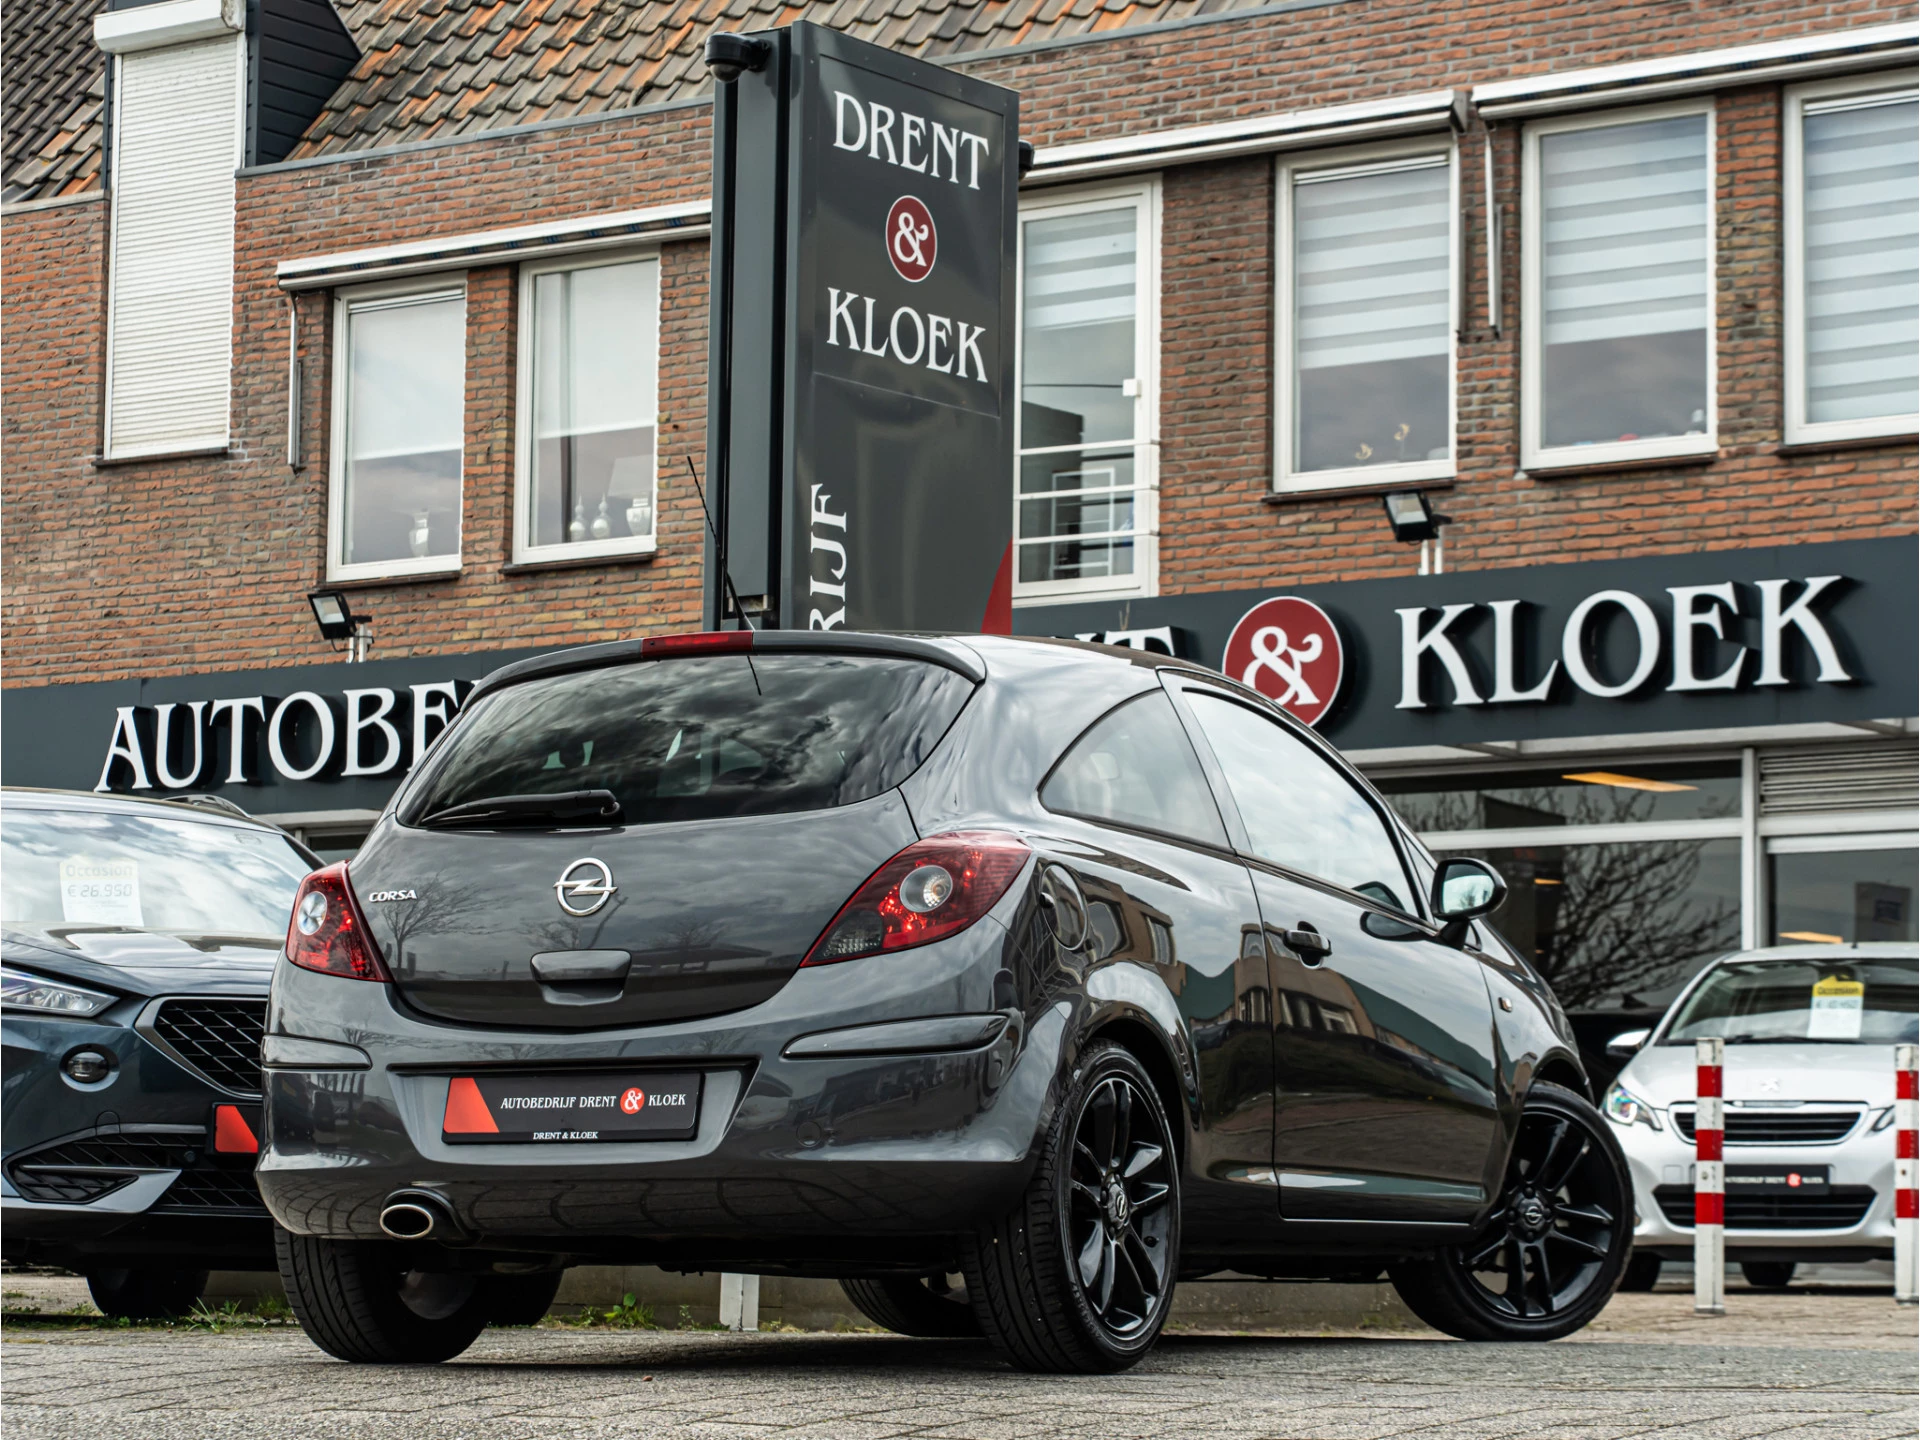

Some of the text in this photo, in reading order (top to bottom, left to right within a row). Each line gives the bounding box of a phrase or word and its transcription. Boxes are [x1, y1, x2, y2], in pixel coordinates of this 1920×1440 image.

[833, 91, 989, 190] DRENT
[893, 212, 929, 267] &
[827, 287, 988, 383] KLOEK
[1242, 575, 1852, 709] & KLOEK
[94, 679, 481, 793] AUTOBE
[66, 864, 133, 877] Occasion
[369, 889, 418, 903] CORSA
[500, 1090, 686, 1111] AUTOBEDRIJF DRENT & KLOEK
[533, 1131, 599, 1140] DRENT & KLOEK
